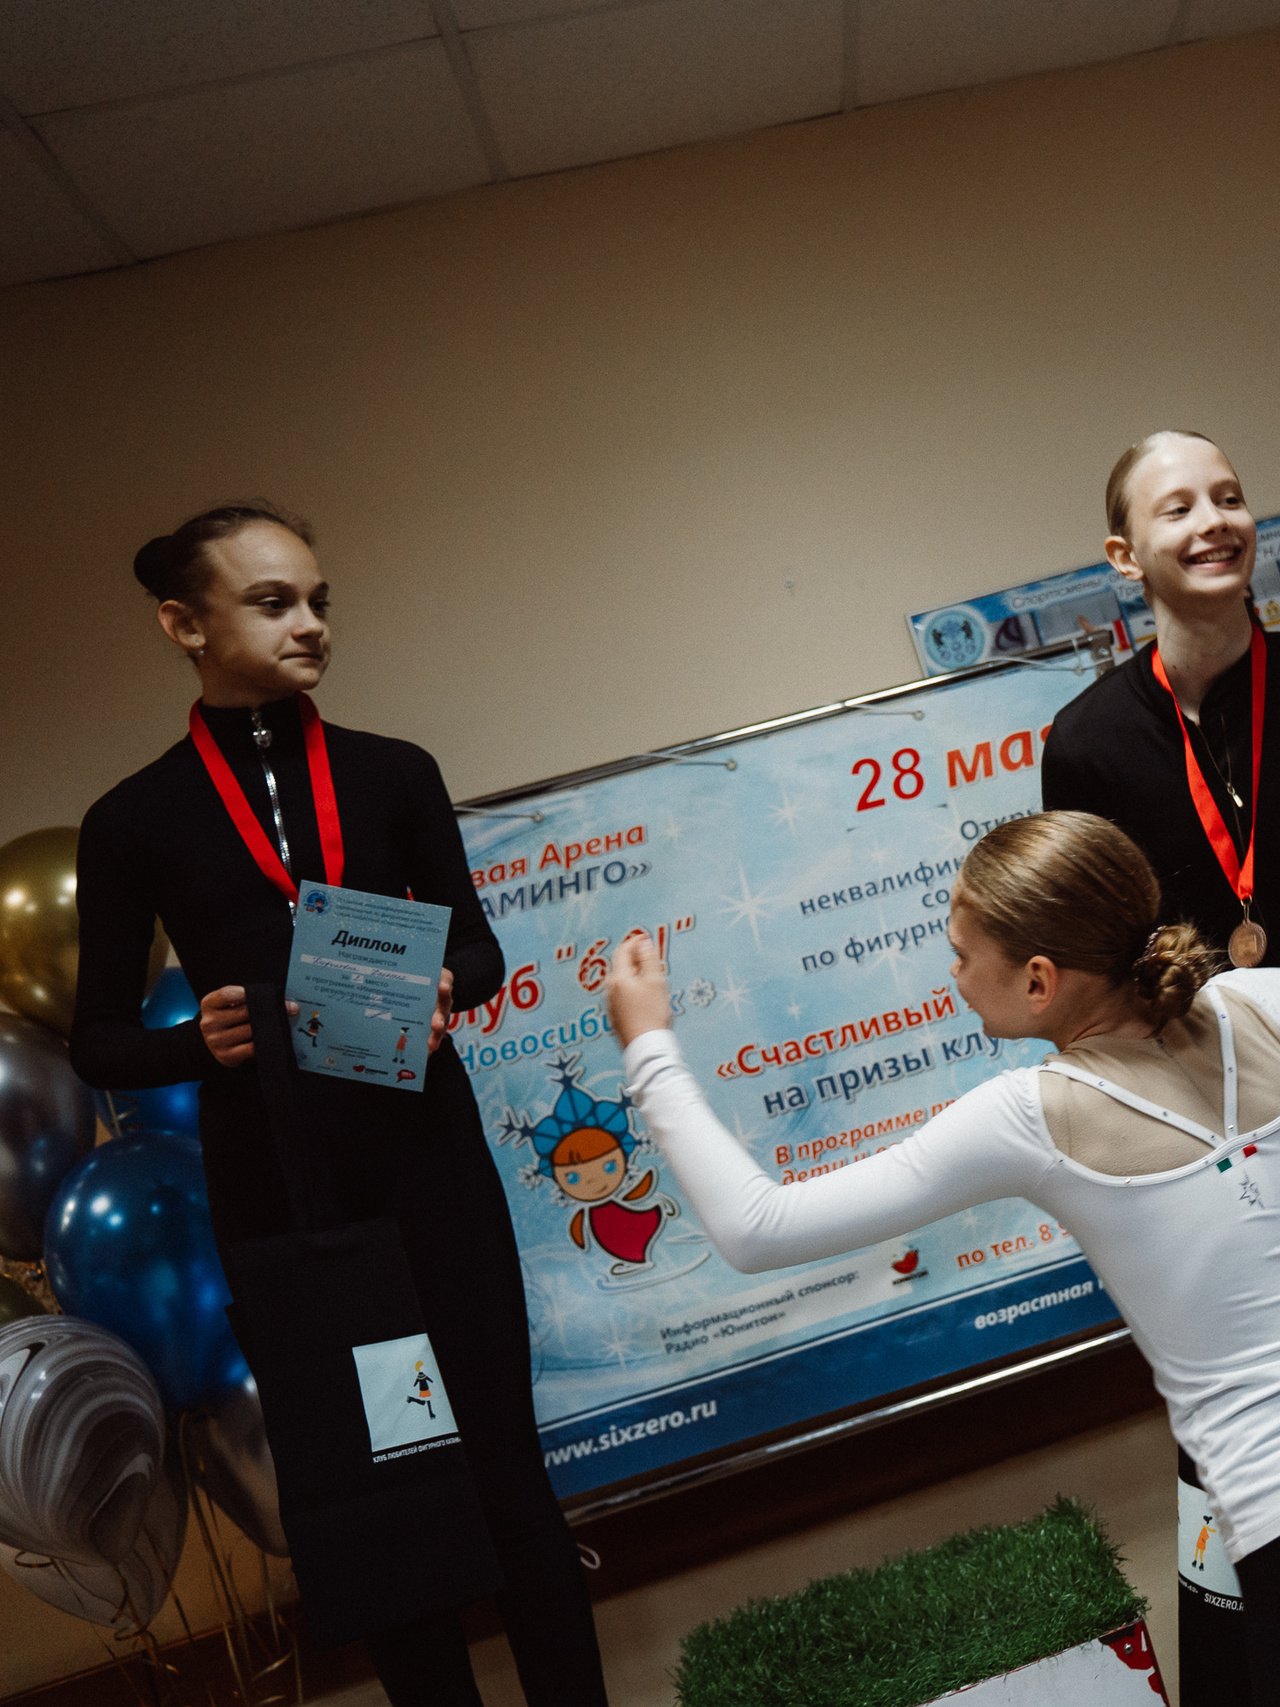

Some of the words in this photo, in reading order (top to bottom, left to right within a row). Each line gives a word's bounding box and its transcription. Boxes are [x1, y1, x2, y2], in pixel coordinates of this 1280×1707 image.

[851, 747, 925, 812] 28
[946, 723, 1053, 788] ма
[538, 825, 645, 870] Арена
[331, 930, 407, 955] Диплом
[803, 950, 834, 972] по
[717, 986, 954, 1078] «Счастливый
[764, 1085, 805, 1115] на
[817, 1048, 930, 1101] призы
[776, 1146, 790, 1165] В
[797, 1109, 925, 1159] программе
[957, 1250, 985, 1268] по
[990, 1236, 1034, 1257] тел.
[1039, 1224, 1052, 1242] 8
[660, 1290, 795, 1341] Информационный
[798, 1270, 859, 1298] спонсор:
[974, 1281, 1093, 1329] возрастная
[665, 1335, 708, 1355] Радио
